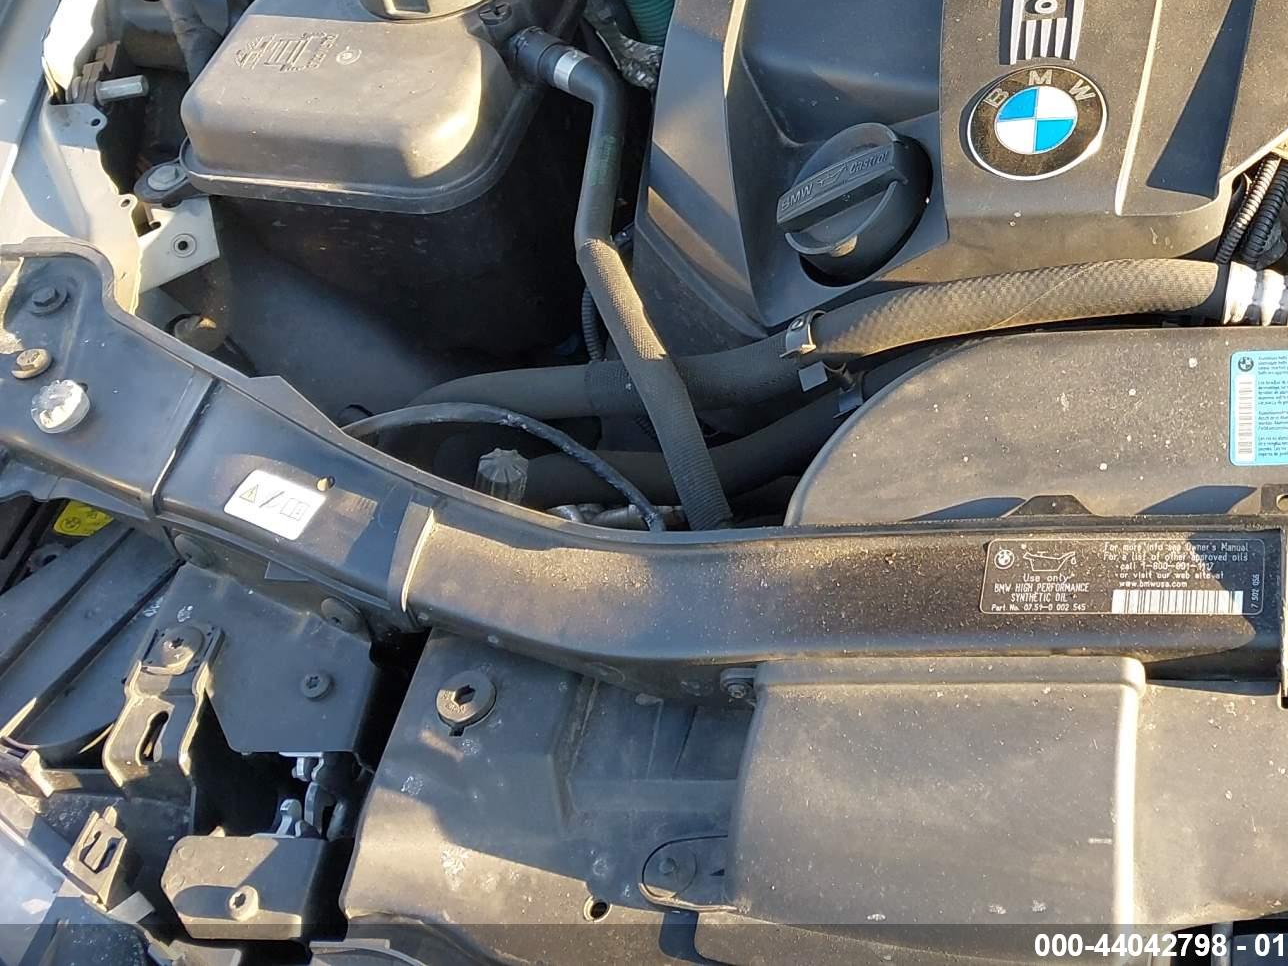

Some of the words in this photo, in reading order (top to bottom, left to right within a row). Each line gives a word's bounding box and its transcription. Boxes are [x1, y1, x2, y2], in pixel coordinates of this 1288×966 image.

[983, 69, 1096, 108] BMW
[782, 184, 814, 210] BMW
[1221, 542, 1249, 552] Manual
[1190, 552, 1228, 563] approved
[1232, 552, 1248, 562] oils
[1023, 573, 1041, 583] Use
[1046, 573, 1069, 585] only
[1119, 579, 1188, 588] www.bmwusa.com
[994, 583, 1012, 593] BMW
[1015, 583, 1034, 593] HIGH
[1036, 583, 1090, 593] PERFORMANCE
[1010, 593, 1052, 603] SYNTHETIC
[1055, 593, 1069, 603] OIL
[991, 603, 1006, 612] Part
